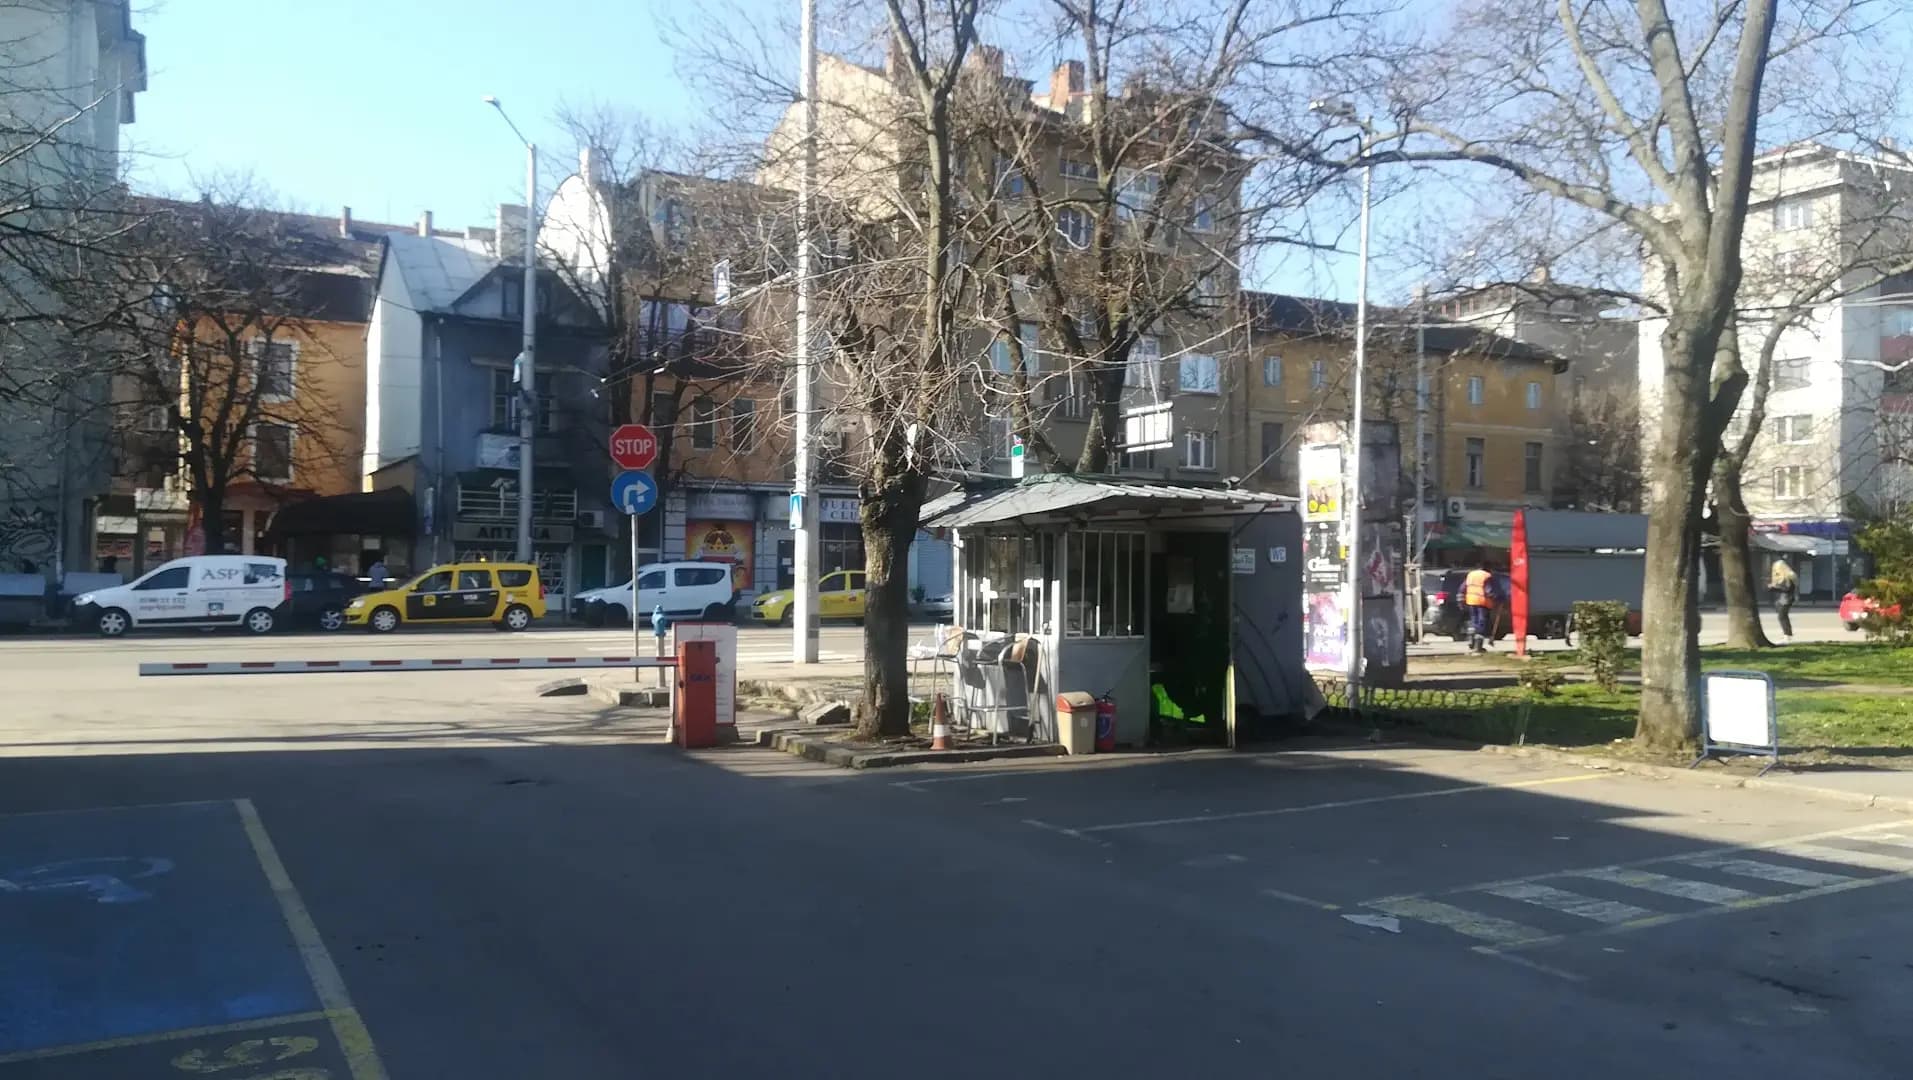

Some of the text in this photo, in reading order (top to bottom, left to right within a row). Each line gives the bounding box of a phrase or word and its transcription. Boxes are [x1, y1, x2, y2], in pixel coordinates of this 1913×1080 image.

[615, 438, 652, 456] STOP
[820, 500, 858, 511] QUEE
[830, 511, 862, 521] CLU
[201, 568, 239, 580] ASP
